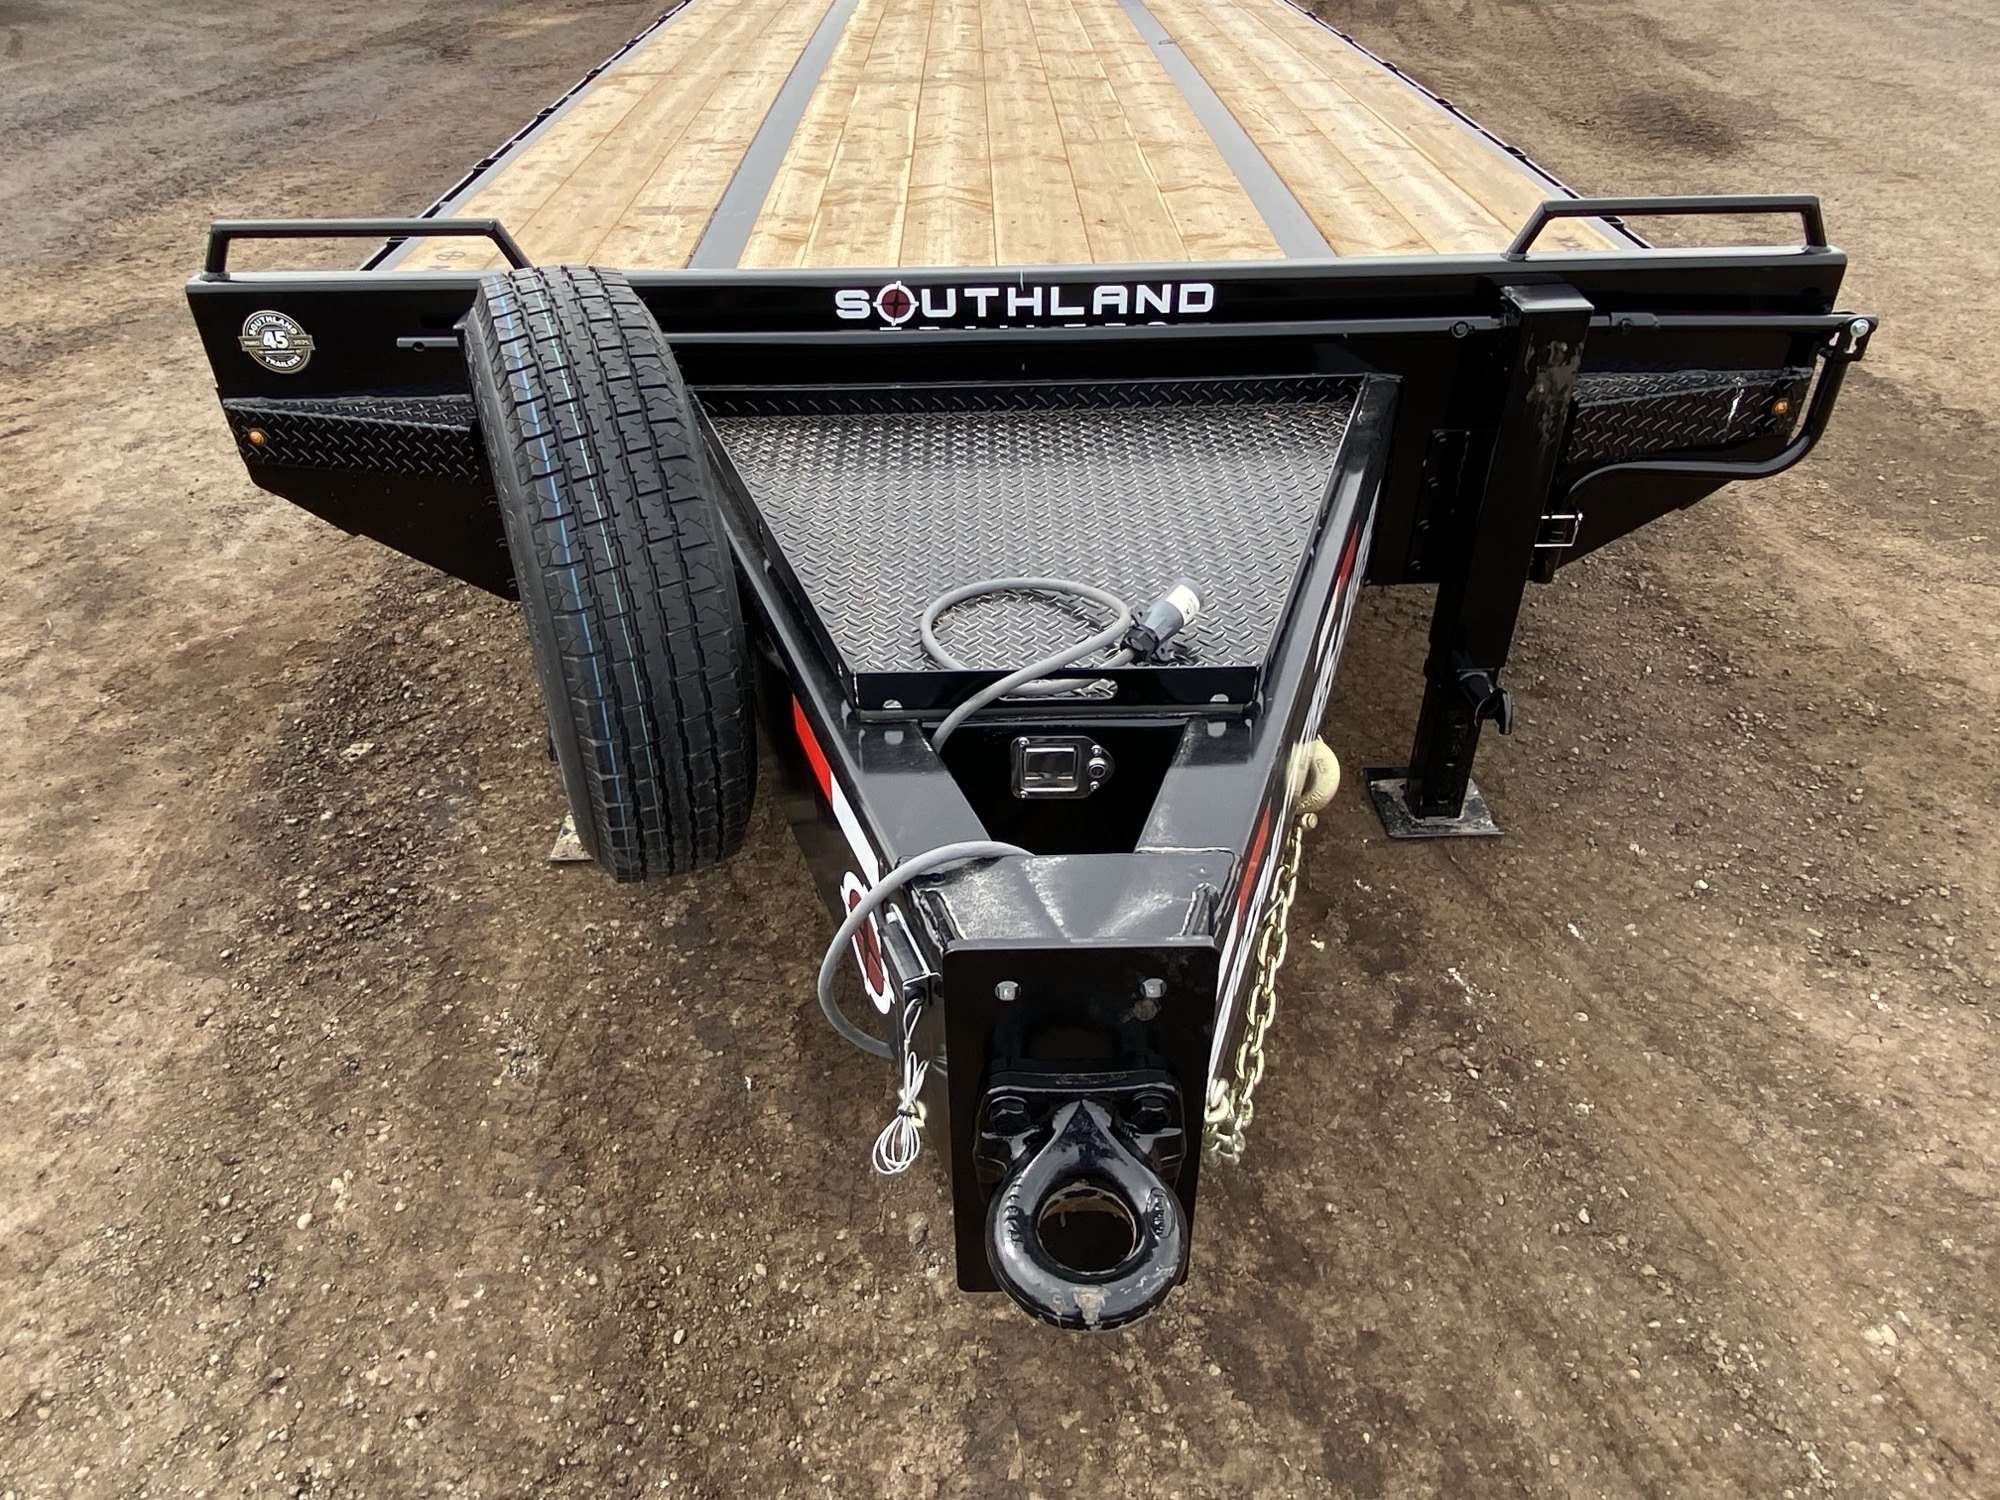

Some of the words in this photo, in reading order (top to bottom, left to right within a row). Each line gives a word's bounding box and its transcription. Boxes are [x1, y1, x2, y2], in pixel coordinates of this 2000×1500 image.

[835, 281, 1214, 325] SOUTHLAND
[249, 315, 298, 336] SOUTHLAND
[263, 330, 289, 349] 45
[265, 355, 301, 368] TRAILERS
